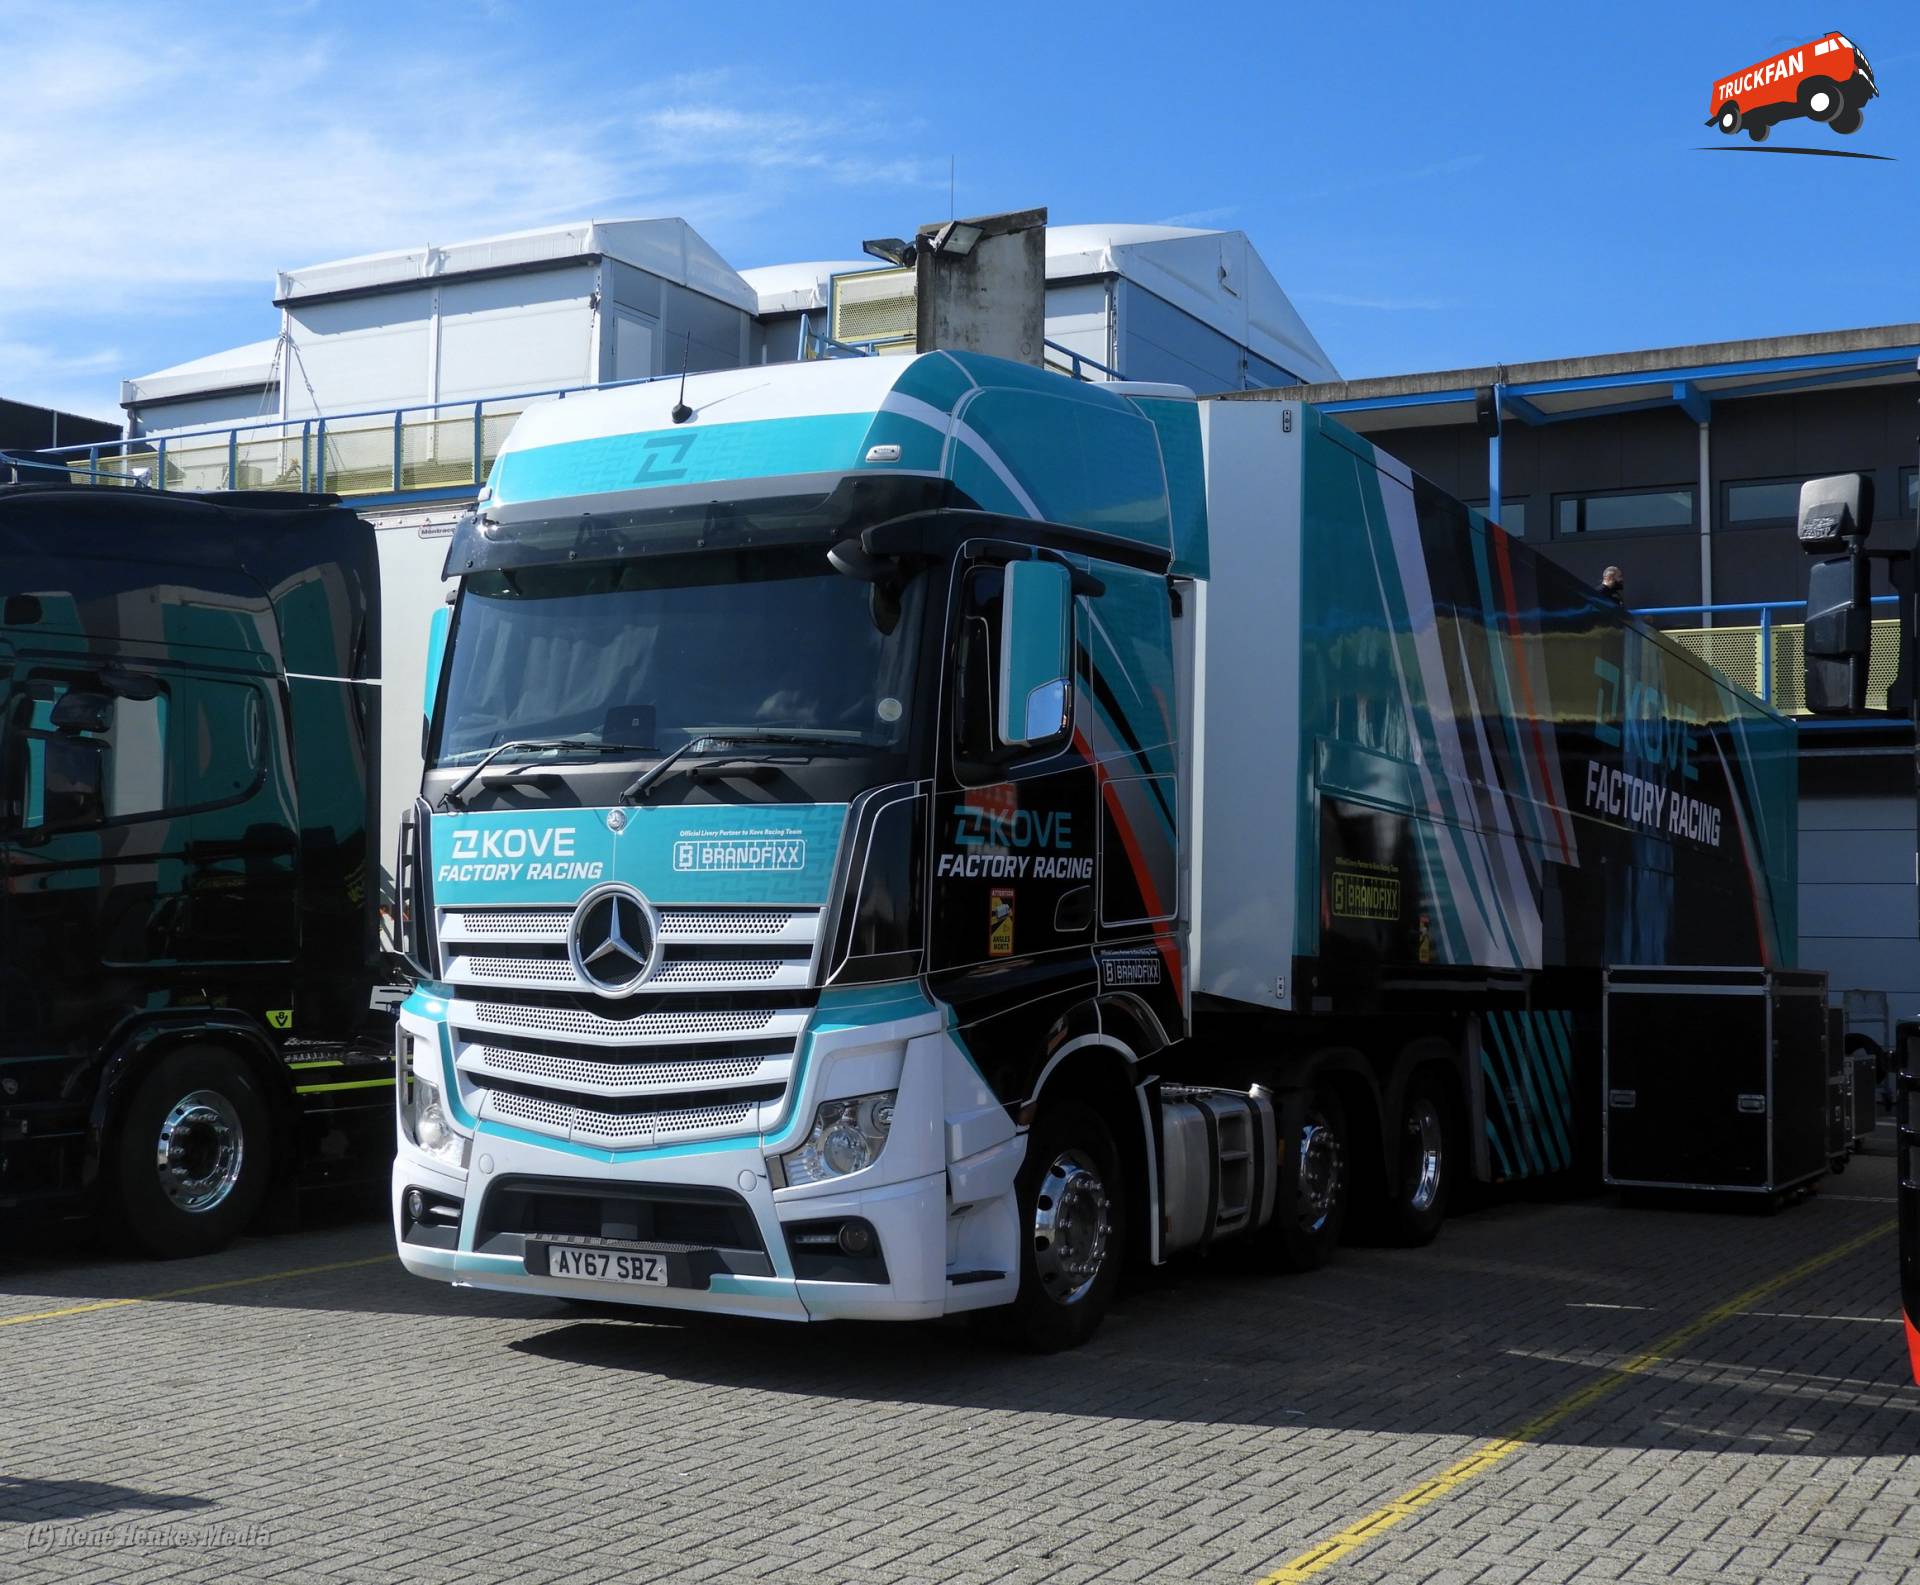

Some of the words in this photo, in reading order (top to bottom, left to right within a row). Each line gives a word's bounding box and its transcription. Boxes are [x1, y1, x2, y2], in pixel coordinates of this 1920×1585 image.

[1586, 760, 1667, 828] FACTORY
[1669, 789, 1721, 847] RACING
[702, 846, 799, 864] BRANDFIXX
[937, 854, 1030, 878] FACTORY
[1032, 856, 1094, 879] RACING
[437, 863, 524, 882] FACTORY
[526, 861, 604, 881] RACING
[1348, 884, 1398, 911] BRANDFIXX
[1117, 964, 1158, 980] BRANDFIXX
[558, 1250, 610, 1277] AY67
[616, 1255, 659, 1281] SBZ
